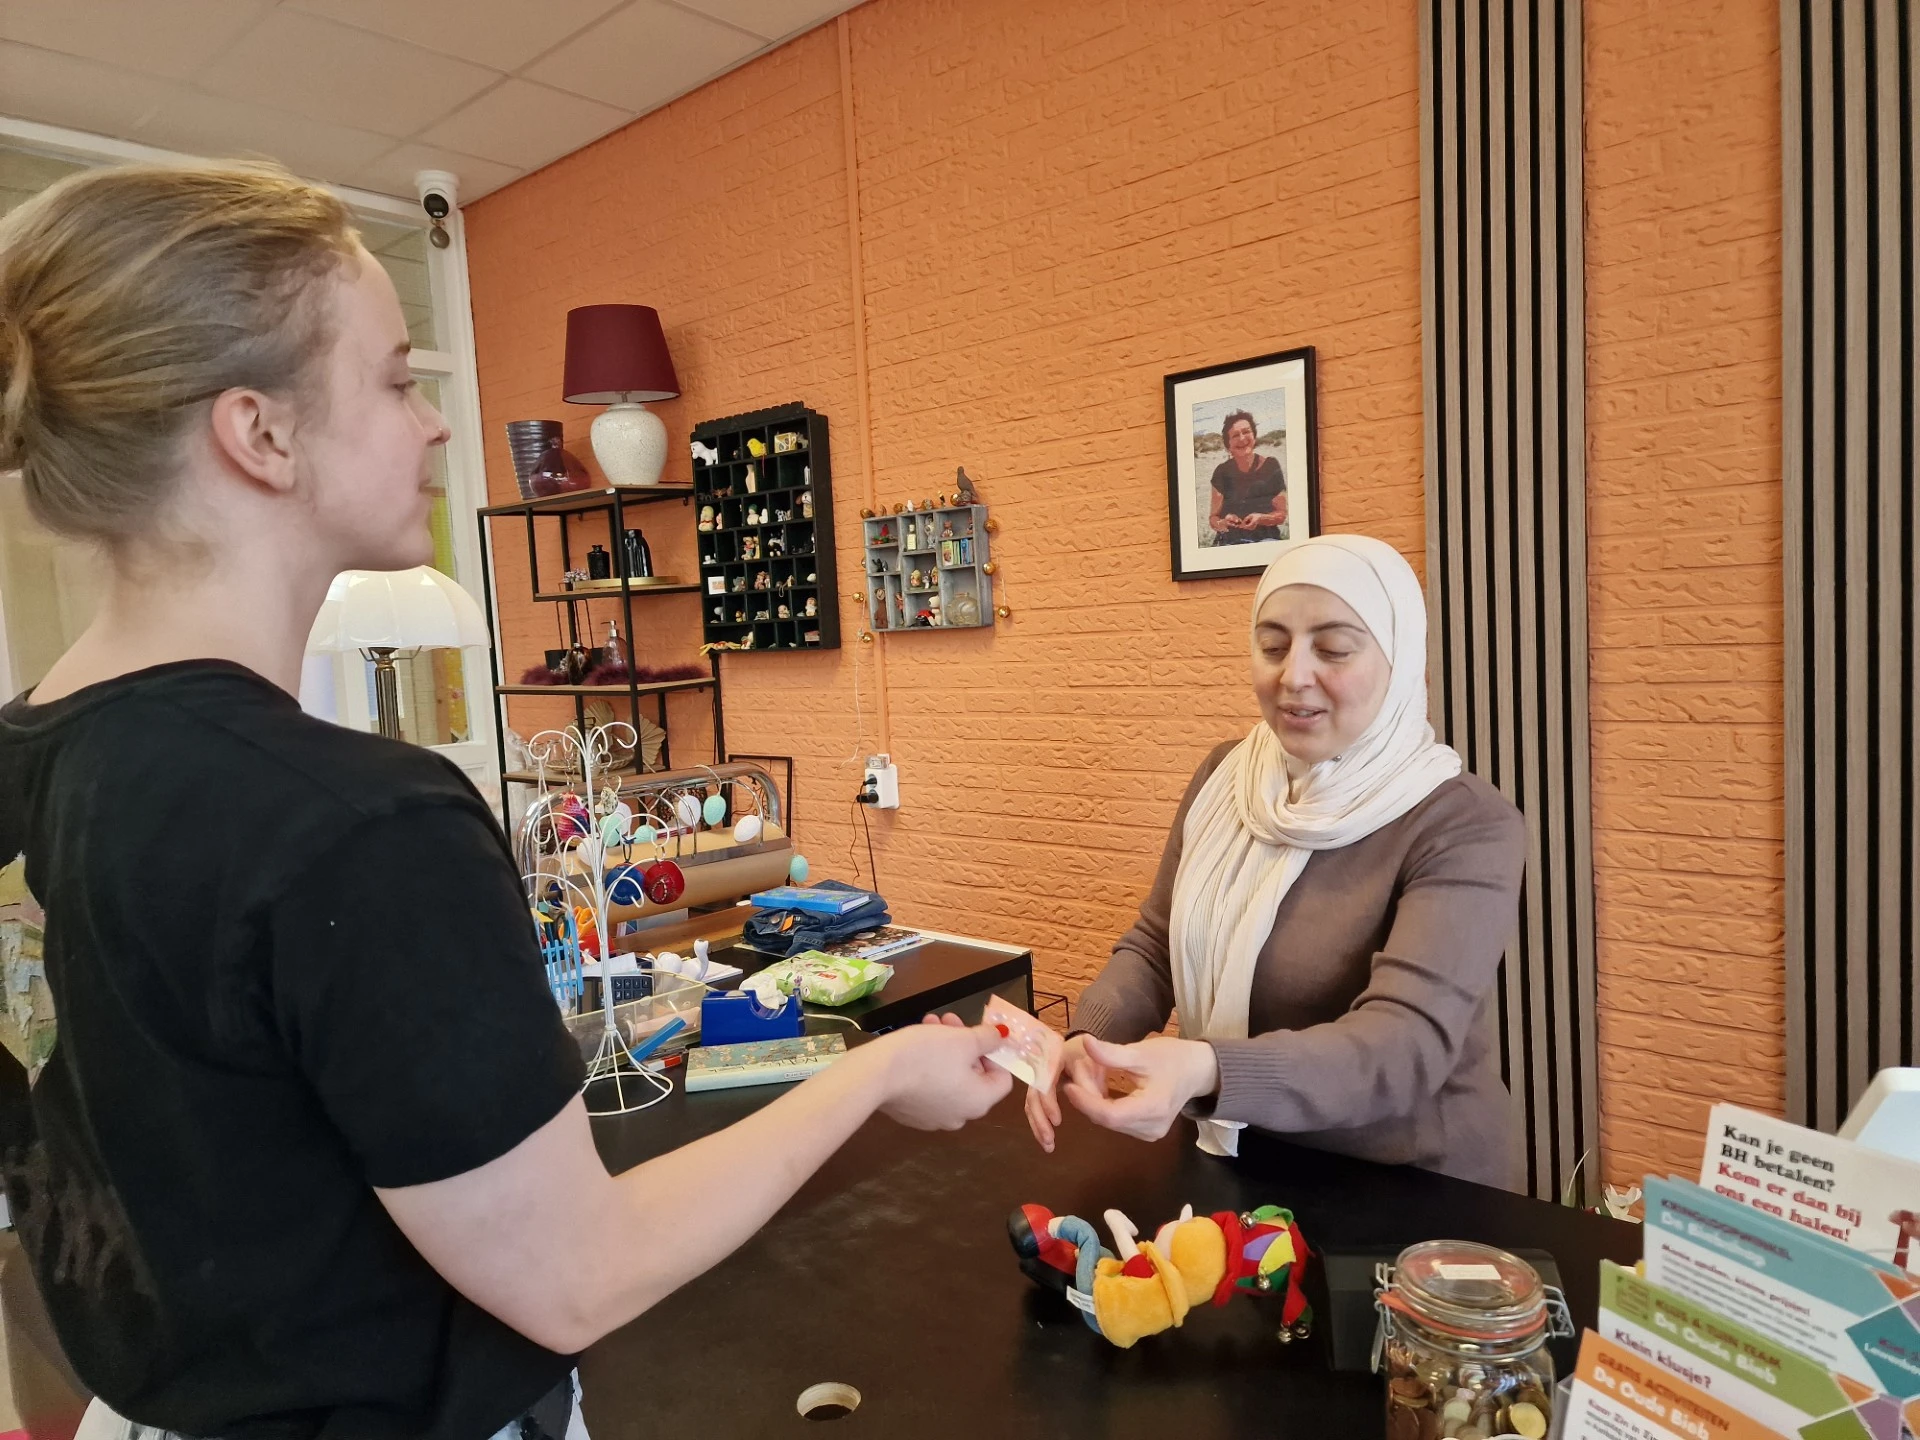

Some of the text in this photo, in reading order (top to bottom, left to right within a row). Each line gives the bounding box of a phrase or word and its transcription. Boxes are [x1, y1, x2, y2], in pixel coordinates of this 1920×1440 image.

[1721, 1143, 1836, 1193] BH betalen?
[1723, 1124, 1835, 1173] Kan je geen
[1715, 1184, 1851, 1241] ons een halen!
[1718, 1162, 1862, 1227] Kom er dan bij
[1597, 1352, 1641, 1383] GRATIS
[1615, 1328, 1712, 1388] Klein klusje?
[1593, 1365, 1616, 1389] De
[1619, 1381, 1666, 1417] Oude
[1671, 1407, 1710, 1440] Bieb
